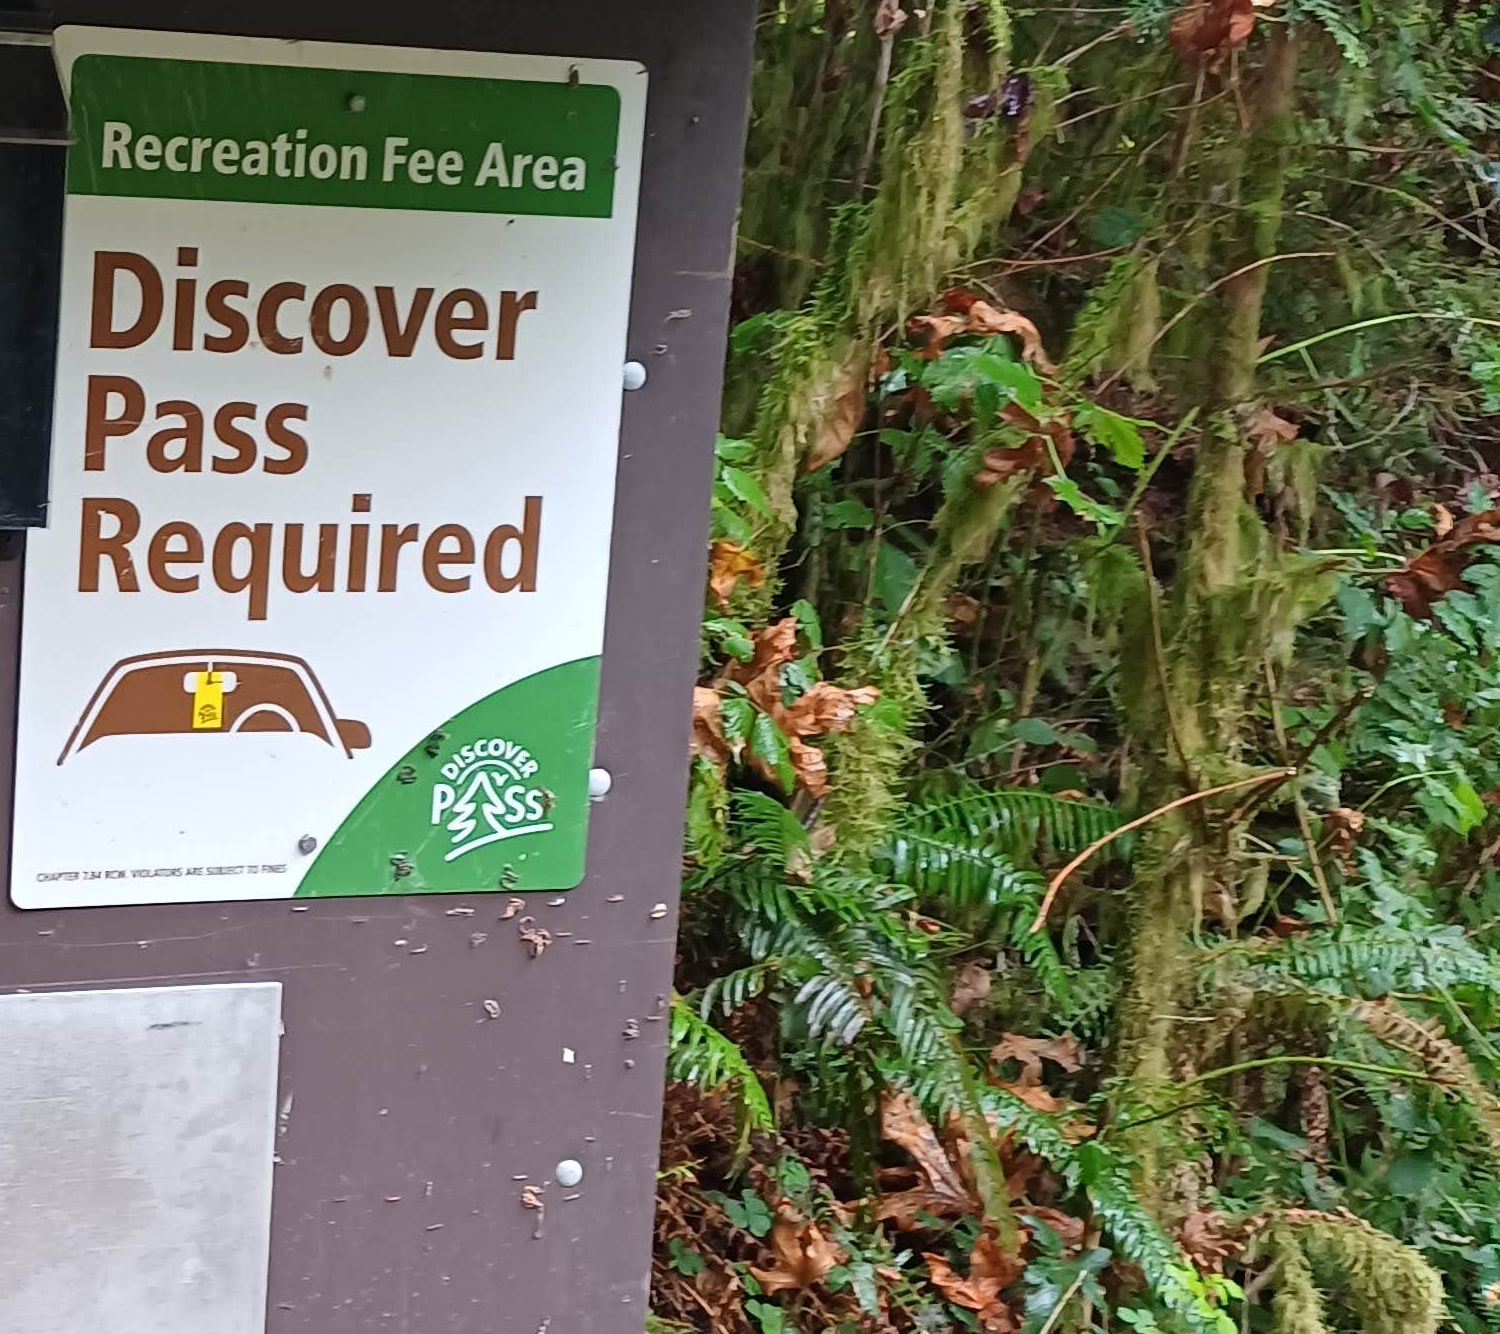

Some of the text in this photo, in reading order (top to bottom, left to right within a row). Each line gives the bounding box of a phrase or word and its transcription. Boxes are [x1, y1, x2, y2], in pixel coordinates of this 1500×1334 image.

[102, 122, 586, 190] Recreation Fee Area
[89, 247, 539, 359] Discover
[84, 375, 308, 475] Pass
[78, 494, 543, 621] Required
[440, 738, 539, 780] DISCOVER
